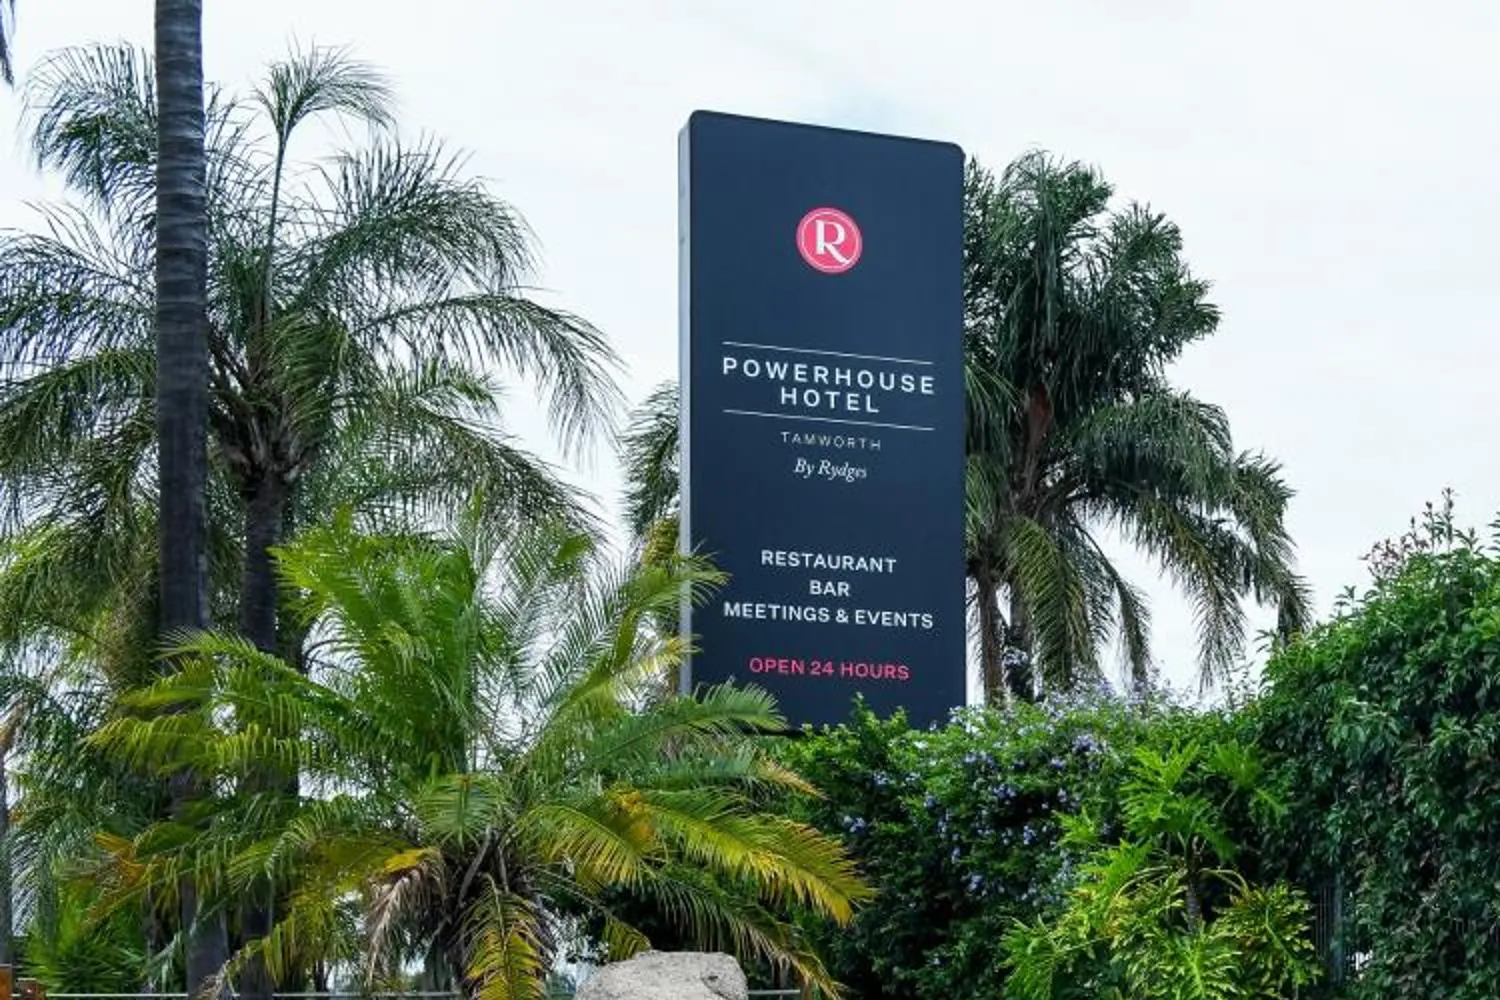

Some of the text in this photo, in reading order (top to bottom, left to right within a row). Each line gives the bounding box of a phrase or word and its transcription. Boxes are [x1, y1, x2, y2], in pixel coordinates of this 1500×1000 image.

[722, 356, 935, 395] POWERHOUSE
[780, 387, 880, 413] HOTEL
[780, 431, 881, 451] TAMWORTH
[794, 457, 867, 482] By Rydges
[761, 550, 897, 573] RESTAURANT
[809, 580, 850, 597] BAR
[723, 602, 934, 629] MEETINGS & EVENTS
[749, 657, 911, 681] OPEN 24 HOURS
